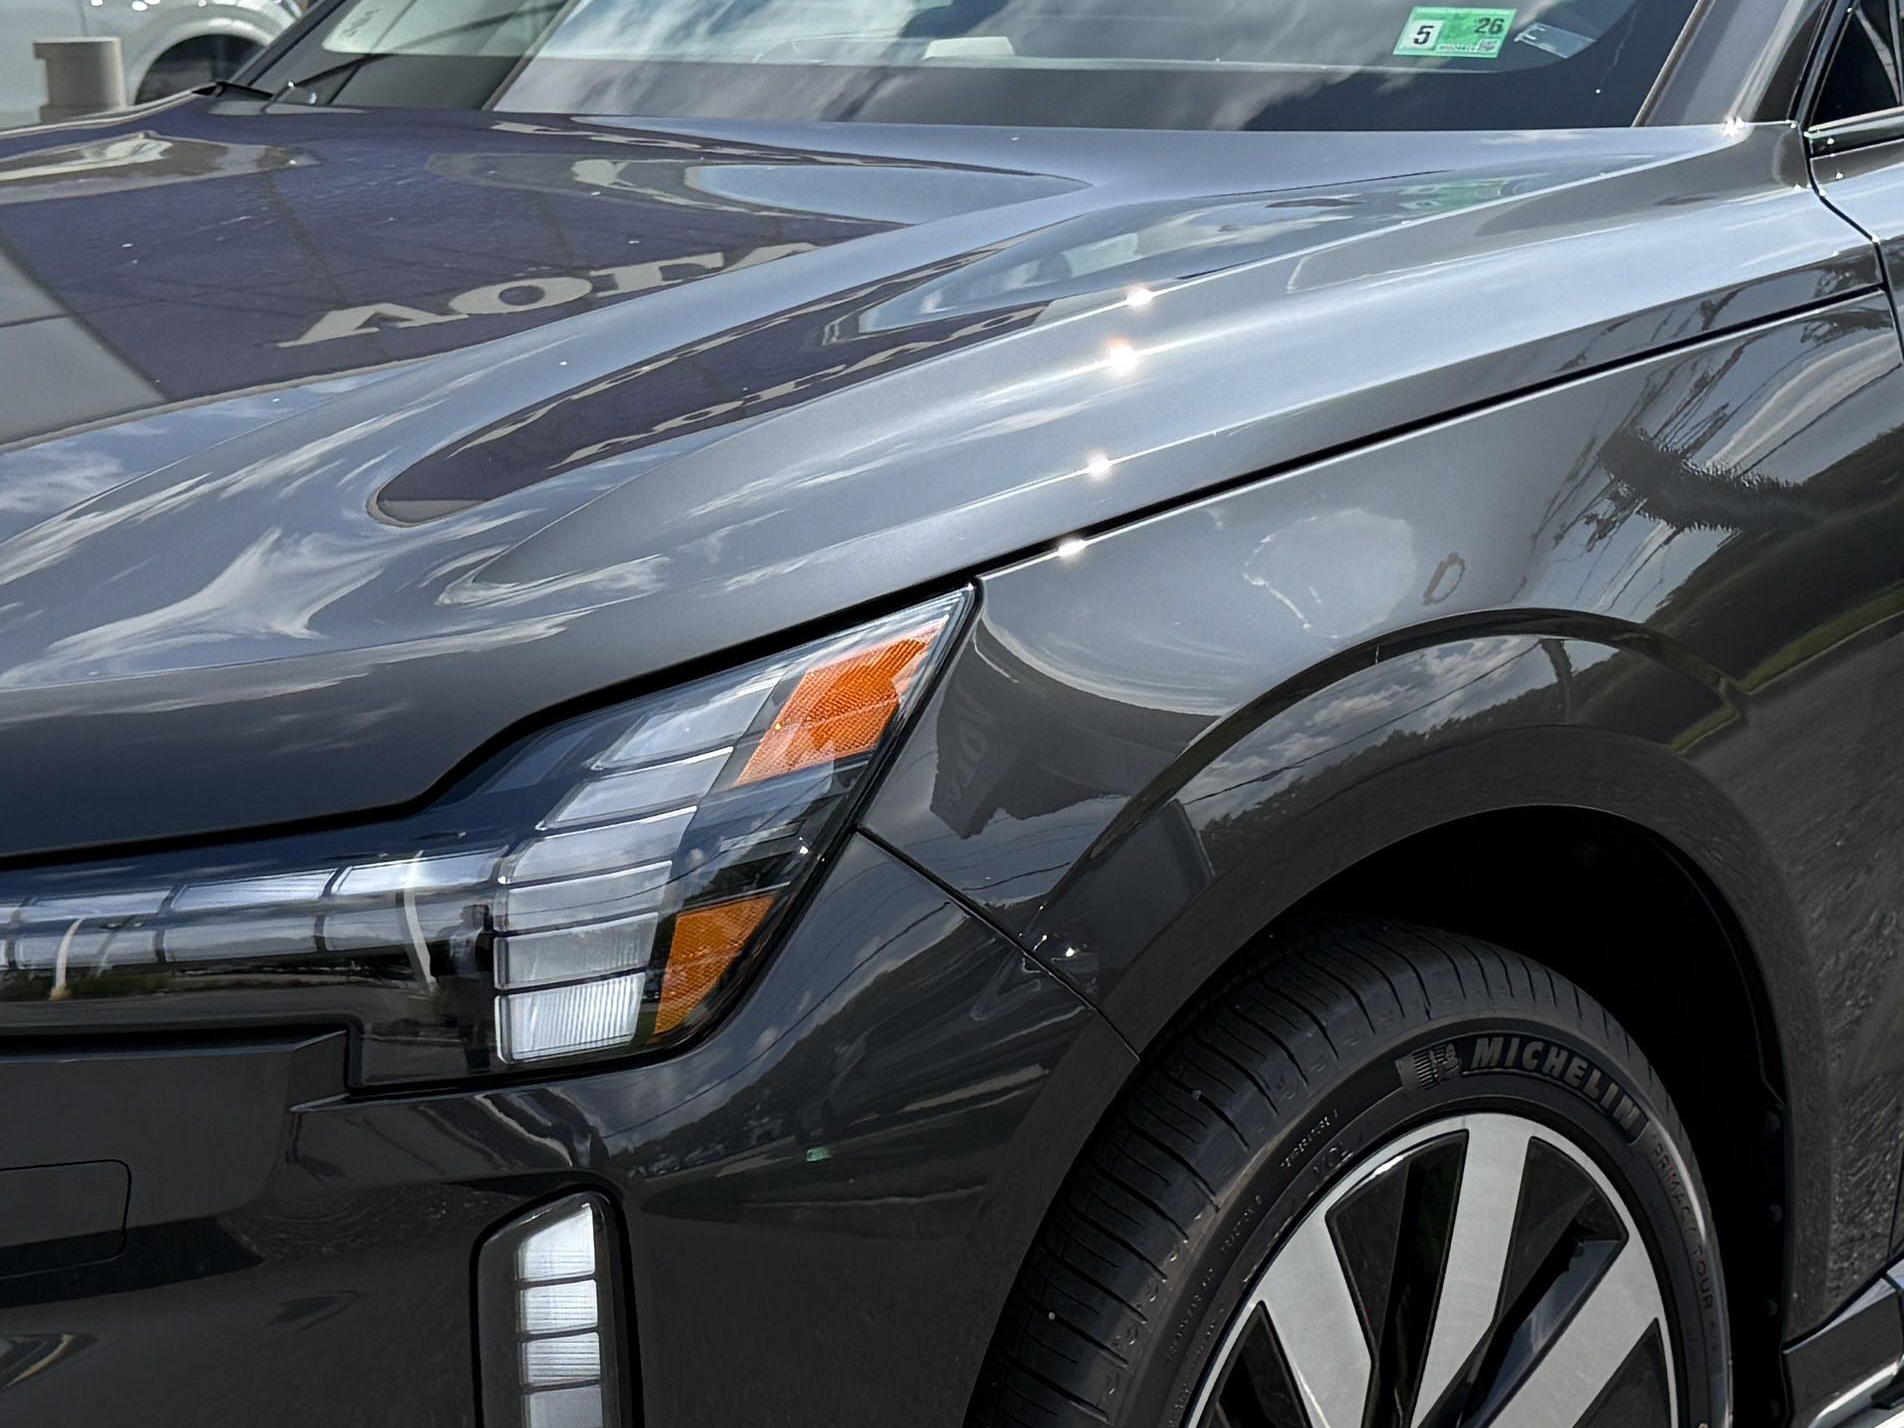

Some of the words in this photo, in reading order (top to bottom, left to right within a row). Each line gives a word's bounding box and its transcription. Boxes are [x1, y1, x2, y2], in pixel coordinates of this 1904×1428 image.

[1413, 25, 1435, 45] 5
[1474, 17, 1505, 35] 26
[1470, 1036, 1642, 1133] MICHELIN
